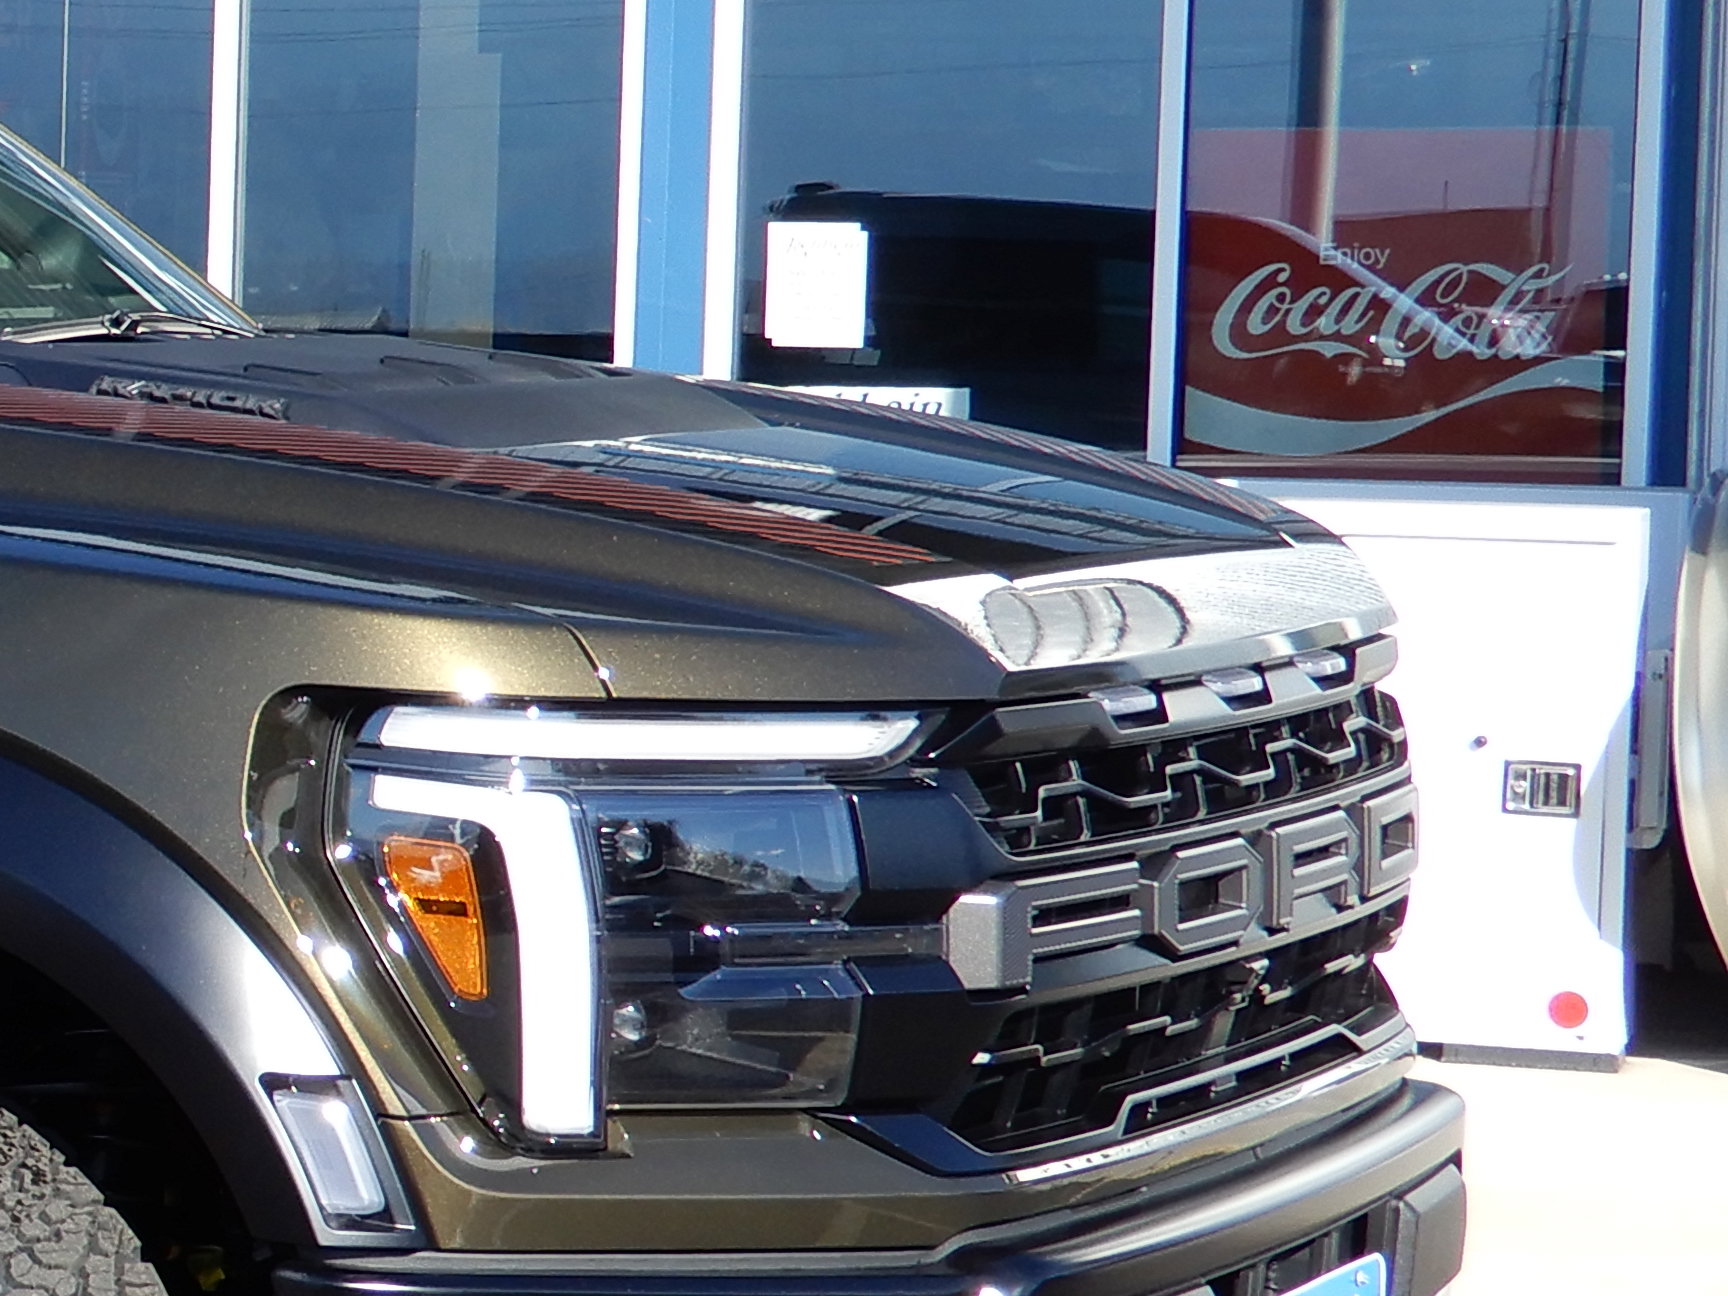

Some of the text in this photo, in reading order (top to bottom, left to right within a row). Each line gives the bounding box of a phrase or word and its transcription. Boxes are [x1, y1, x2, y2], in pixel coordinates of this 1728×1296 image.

[1319, 242, 1391, 269] Enjoy
[1211, 261, 1574, 360] Coca-Cola
[942, 784, 1419, 990] FORD
